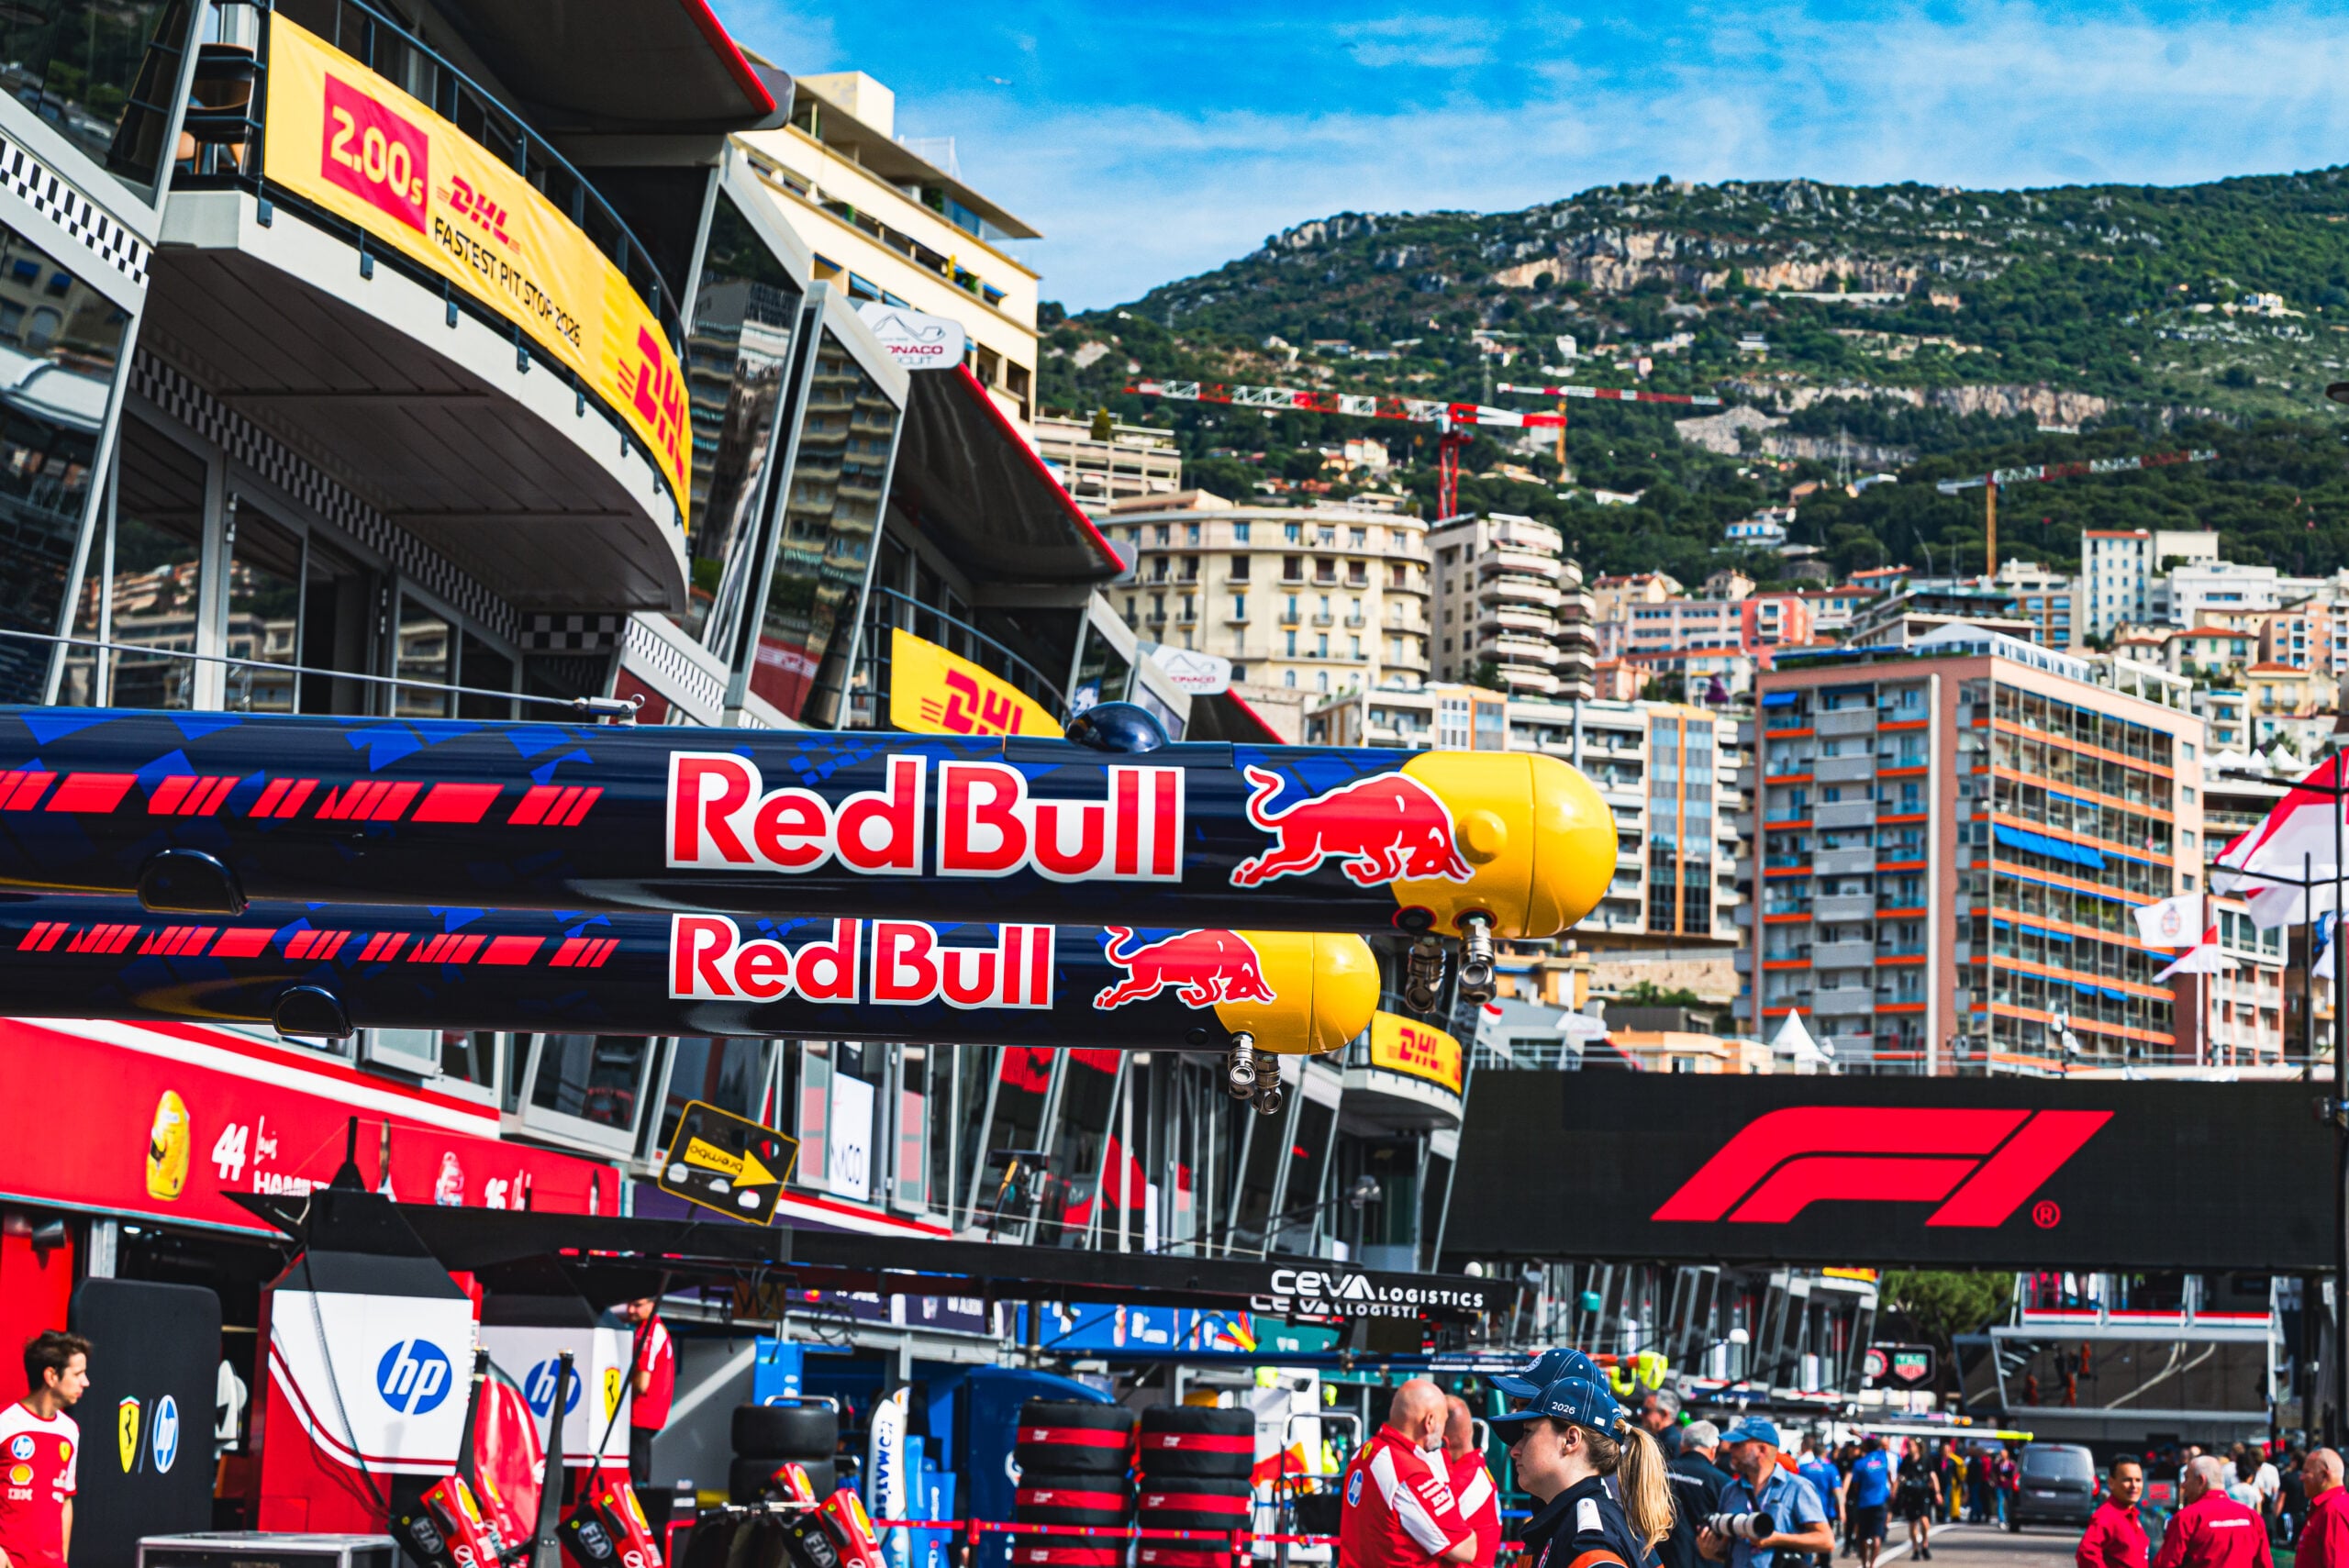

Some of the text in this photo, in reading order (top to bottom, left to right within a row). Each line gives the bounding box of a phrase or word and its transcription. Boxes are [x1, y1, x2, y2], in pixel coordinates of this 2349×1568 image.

[450, 175, 507, 246] DHL
[435, 217, 581, 348] FASTEST PIT STOP 2026
[633, 324, 685, 488] DHL
[674, 756, 1178, 877] Red Bull
[674, 917, 1052, 1006] Red Bull
[1399, 1028, 1438, 1070] DHL
[212, 1123, 249, 1182] 44
[689, 1144, 744, 1174] brembo
[1379, 1286, 1483, 1307] LOGISTICS
[377, 1339, 452, 1415] hp
[1551, 1401, 1575, 1416] 2026
